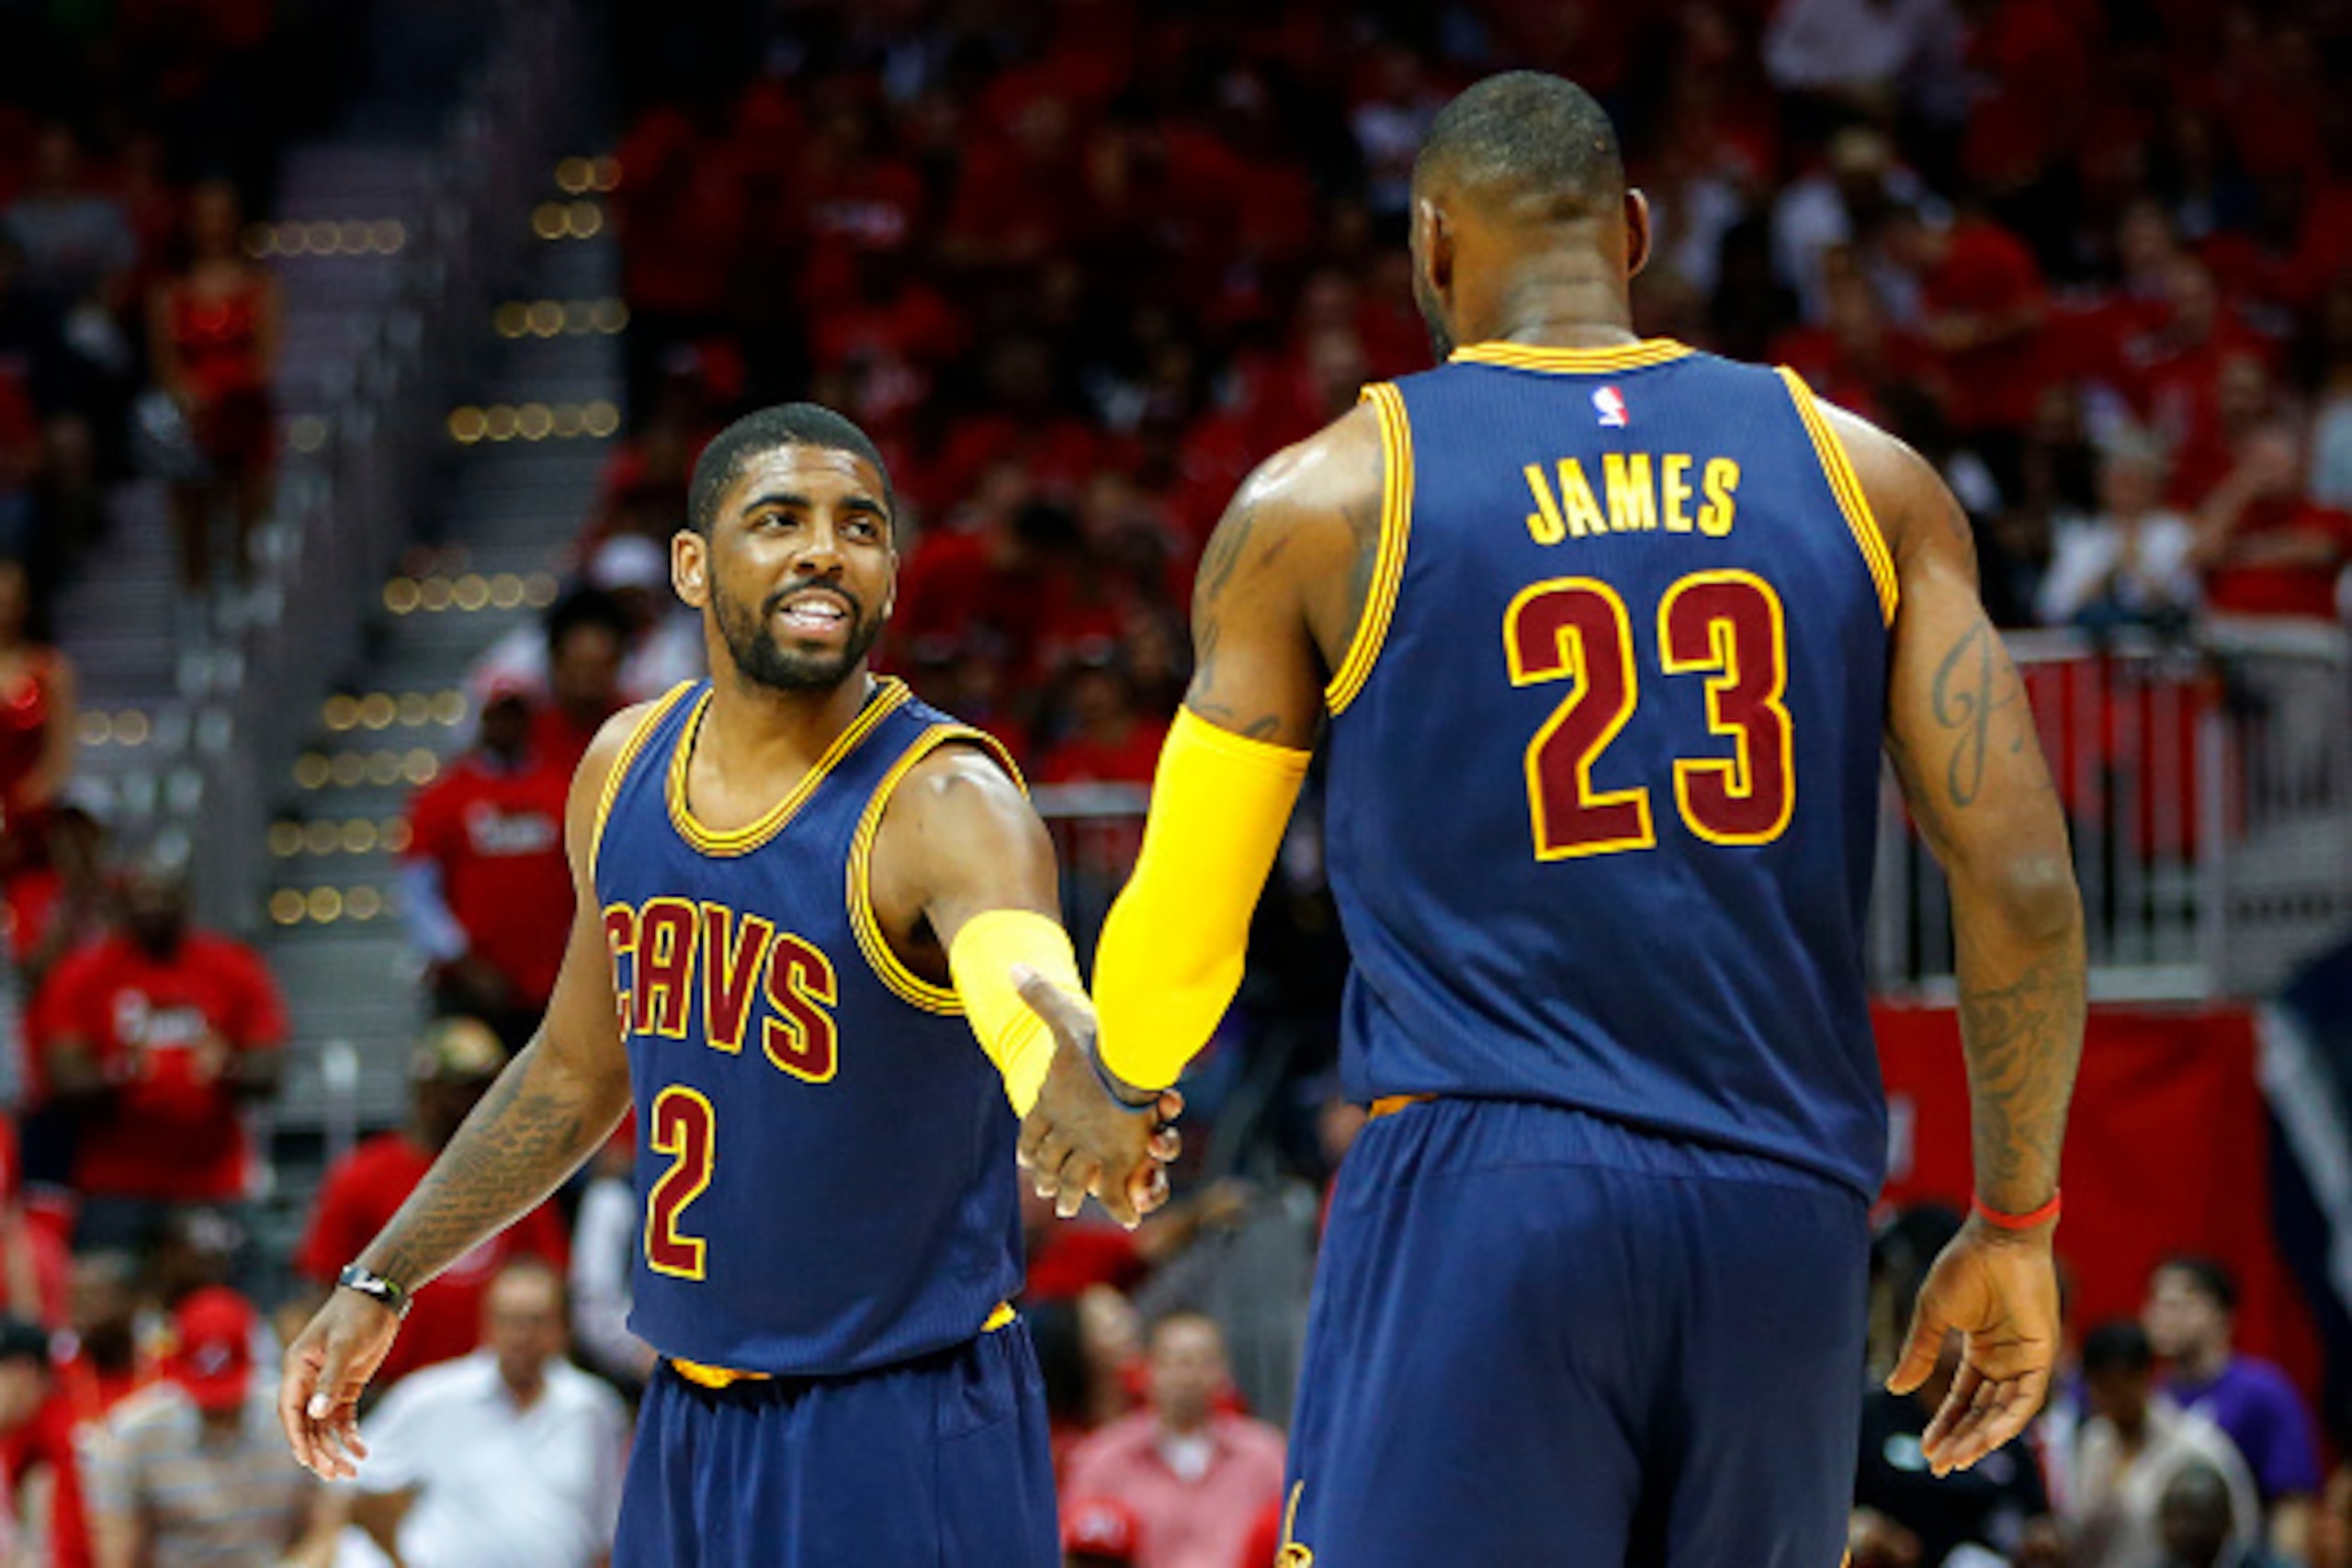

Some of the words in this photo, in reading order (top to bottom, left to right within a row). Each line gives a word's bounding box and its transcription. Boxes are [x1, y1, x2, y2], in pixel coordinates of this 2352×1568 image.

[1523, 453, 1741, 546] JAMES
[1502, 568, 1796, 863] 23
[645, 1084, 717, 1281] 2
